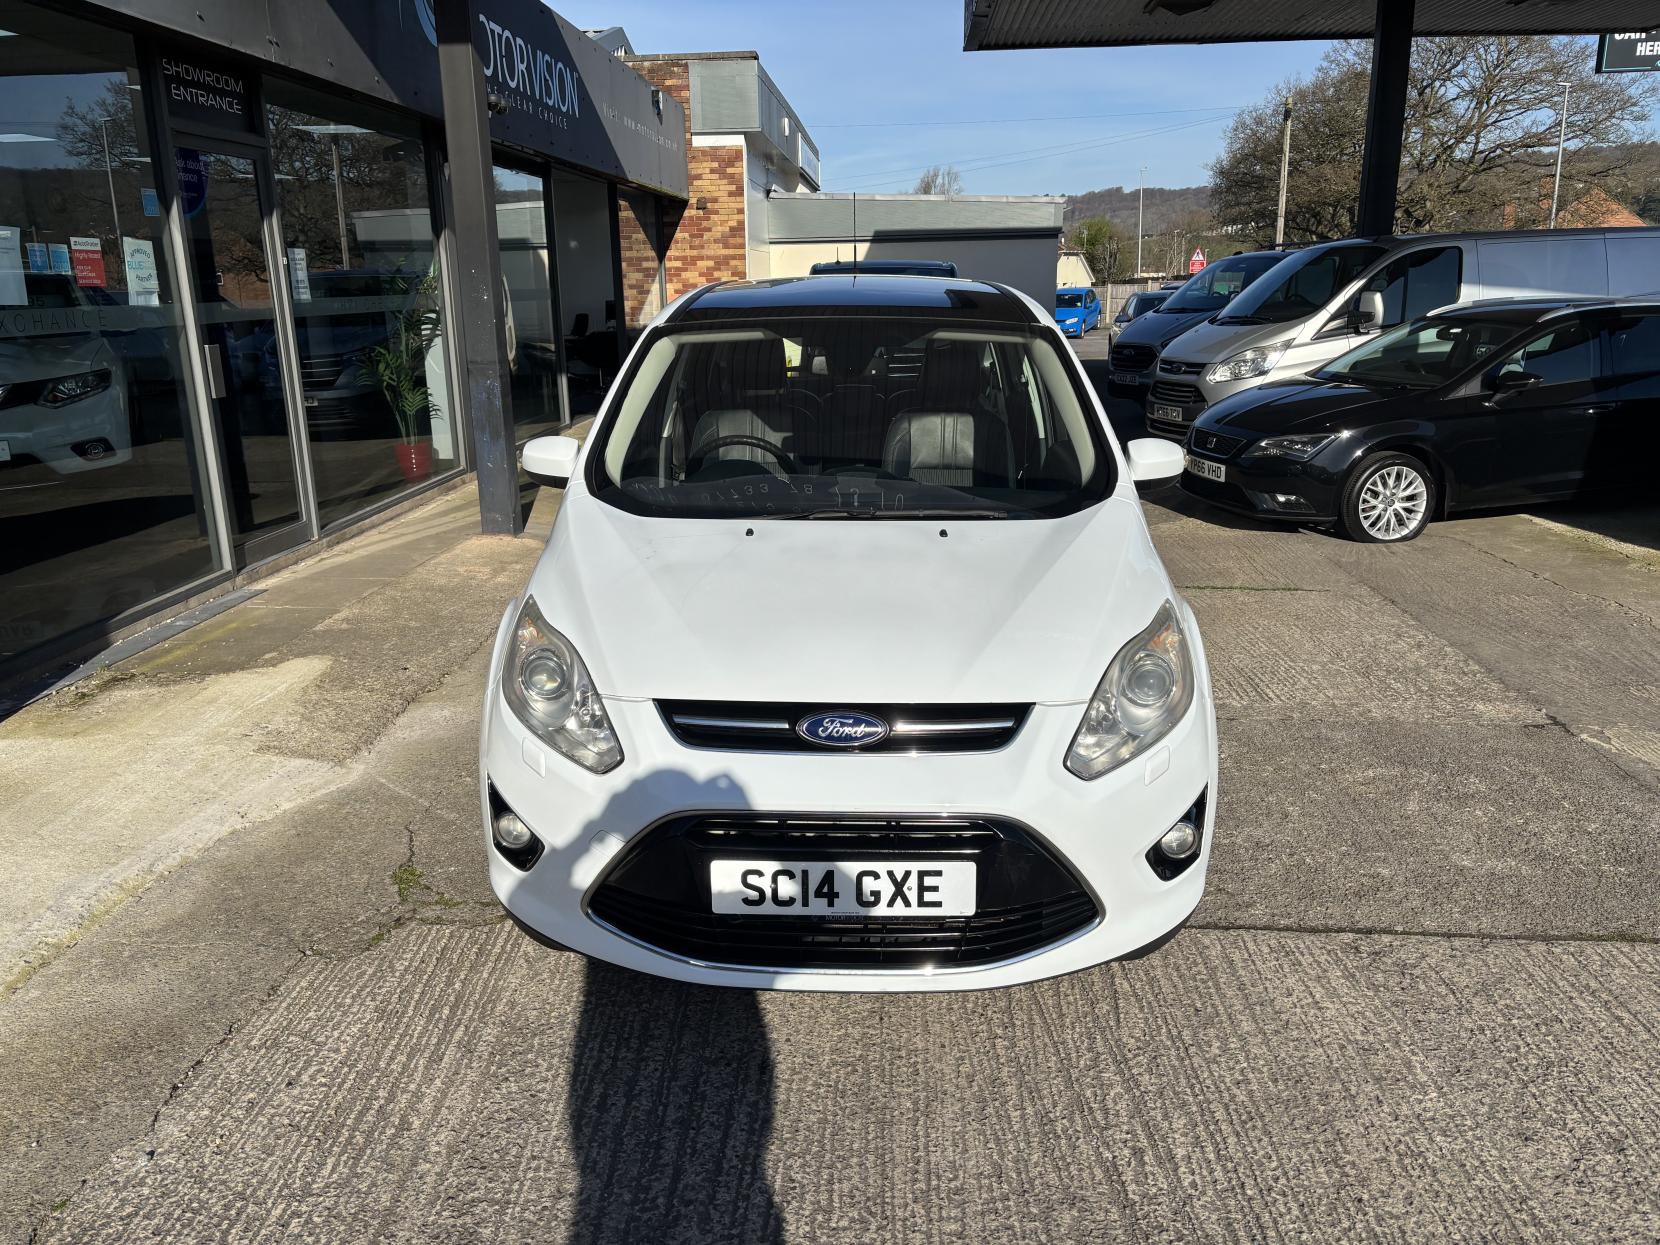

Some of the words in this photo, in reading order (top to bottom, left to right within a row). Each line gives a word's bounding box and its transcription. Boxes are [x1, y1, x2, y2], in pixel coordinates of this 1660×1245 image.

[162, 58, 244, 94] SHOWROOM
[479, 14, 579, 118] OTORVISION
[171, 83, 243, 114] ENTRANCE
[538, 107, 568, 130] CHOICE
[1207, 463, 1222, 479] VHD
[818, 716, 867, 739] Ford
[740, 869, 840, 908] SC14
[855, 869, 944, 908] GXE
